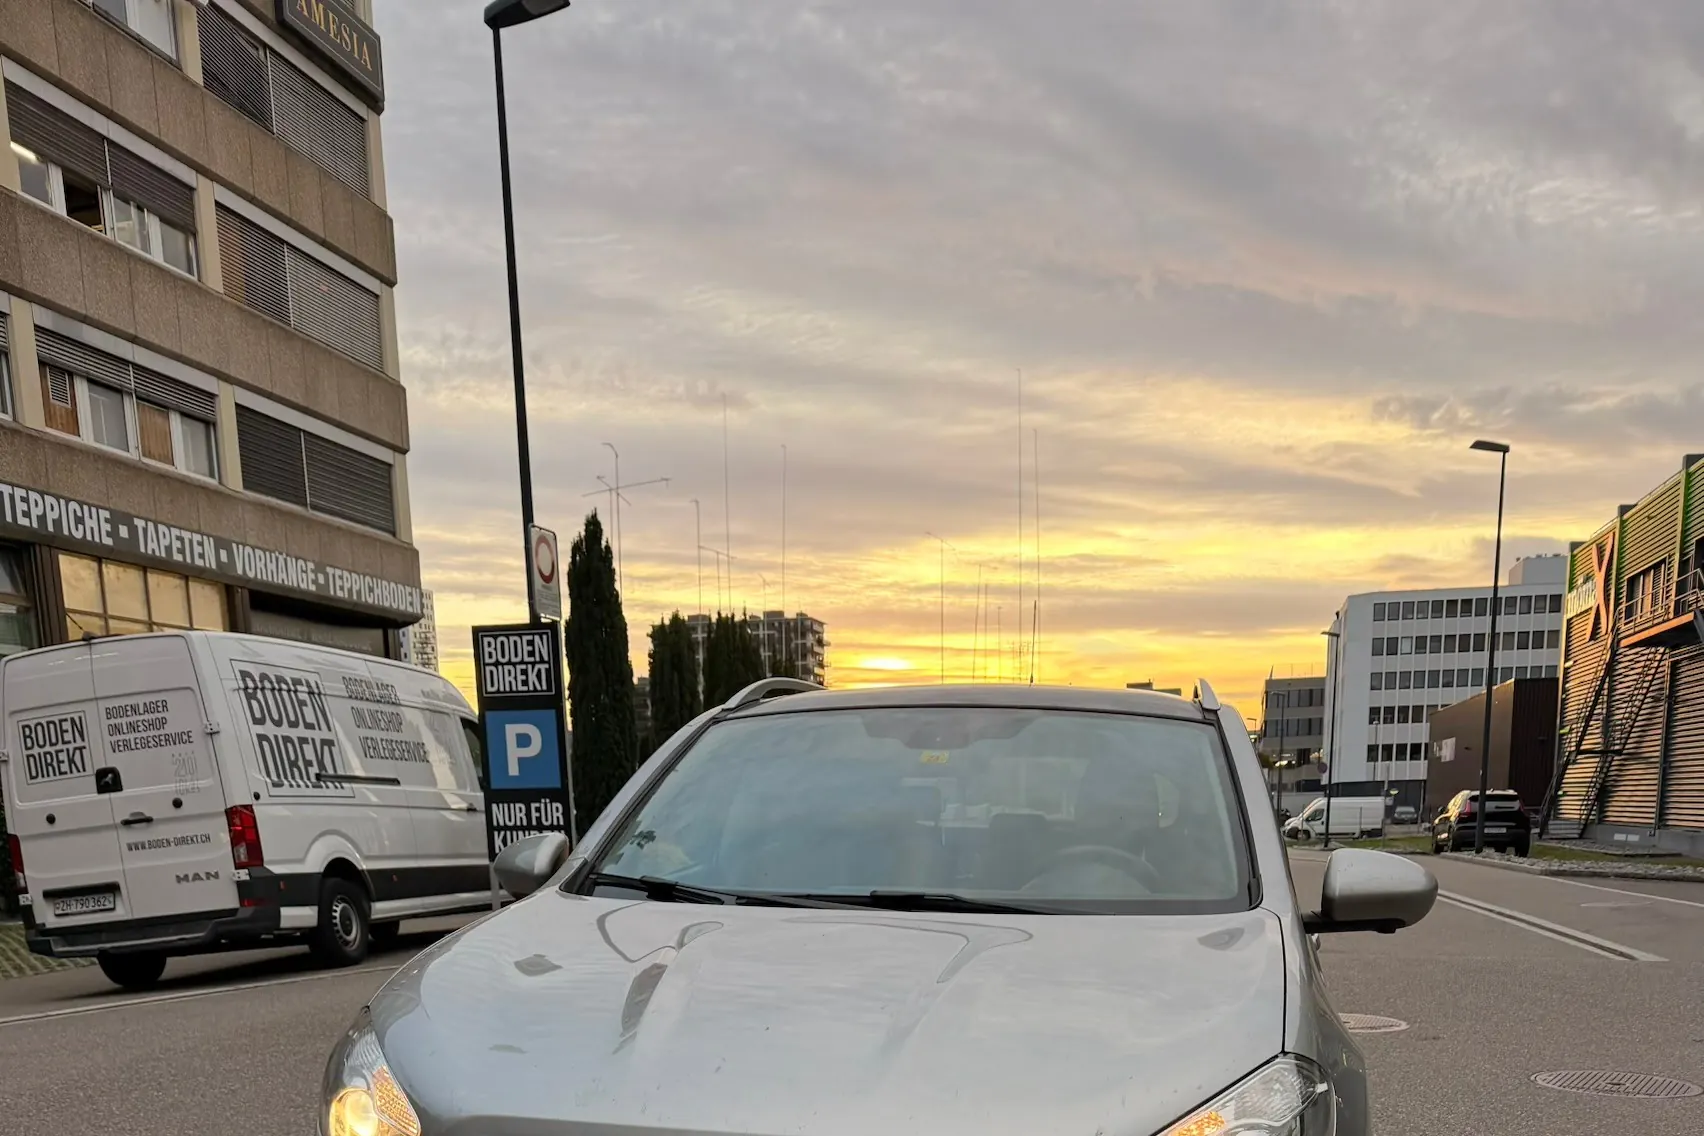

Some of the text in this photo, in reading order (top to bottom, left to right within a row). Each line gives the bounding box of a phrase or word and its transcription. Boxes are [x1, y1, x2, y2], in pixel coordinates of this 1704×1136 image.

[0, 483, 114, 546] TEPPICHE
[133, 517, 217, 570] TAPETEN
[231, 542, 316, 591] VORHÄNGE
[483, 634, 549, 664] BODEN
[341, 676, 400, 703] BODENLAGER
[485, 663, 549, 693] DIREKT
[105, 700, 169, 720] BODENLAGER
[239, 669, 332, 732] BODEN
[22, 715, 86, 751] BODEN
[107, 717, 168, 737] ONLINESHOP
[350, 706, 404, 734] ONLINESHOP
[109, 731, 194, 754] VERLEGESERVICE
[358, 735, 431, 764] VERLEGESERVICE
[505, 723, 543, 777] P
[25, 746, 88, 781] DIREKT
[256, 732, 345, 790] DIREKT
[491, 798, 564, 827] NUR FÜR
[126, 833, 211, 852] WWW.BODEN-DIREKT.CH
[175, 870, 220, 884] MAN
